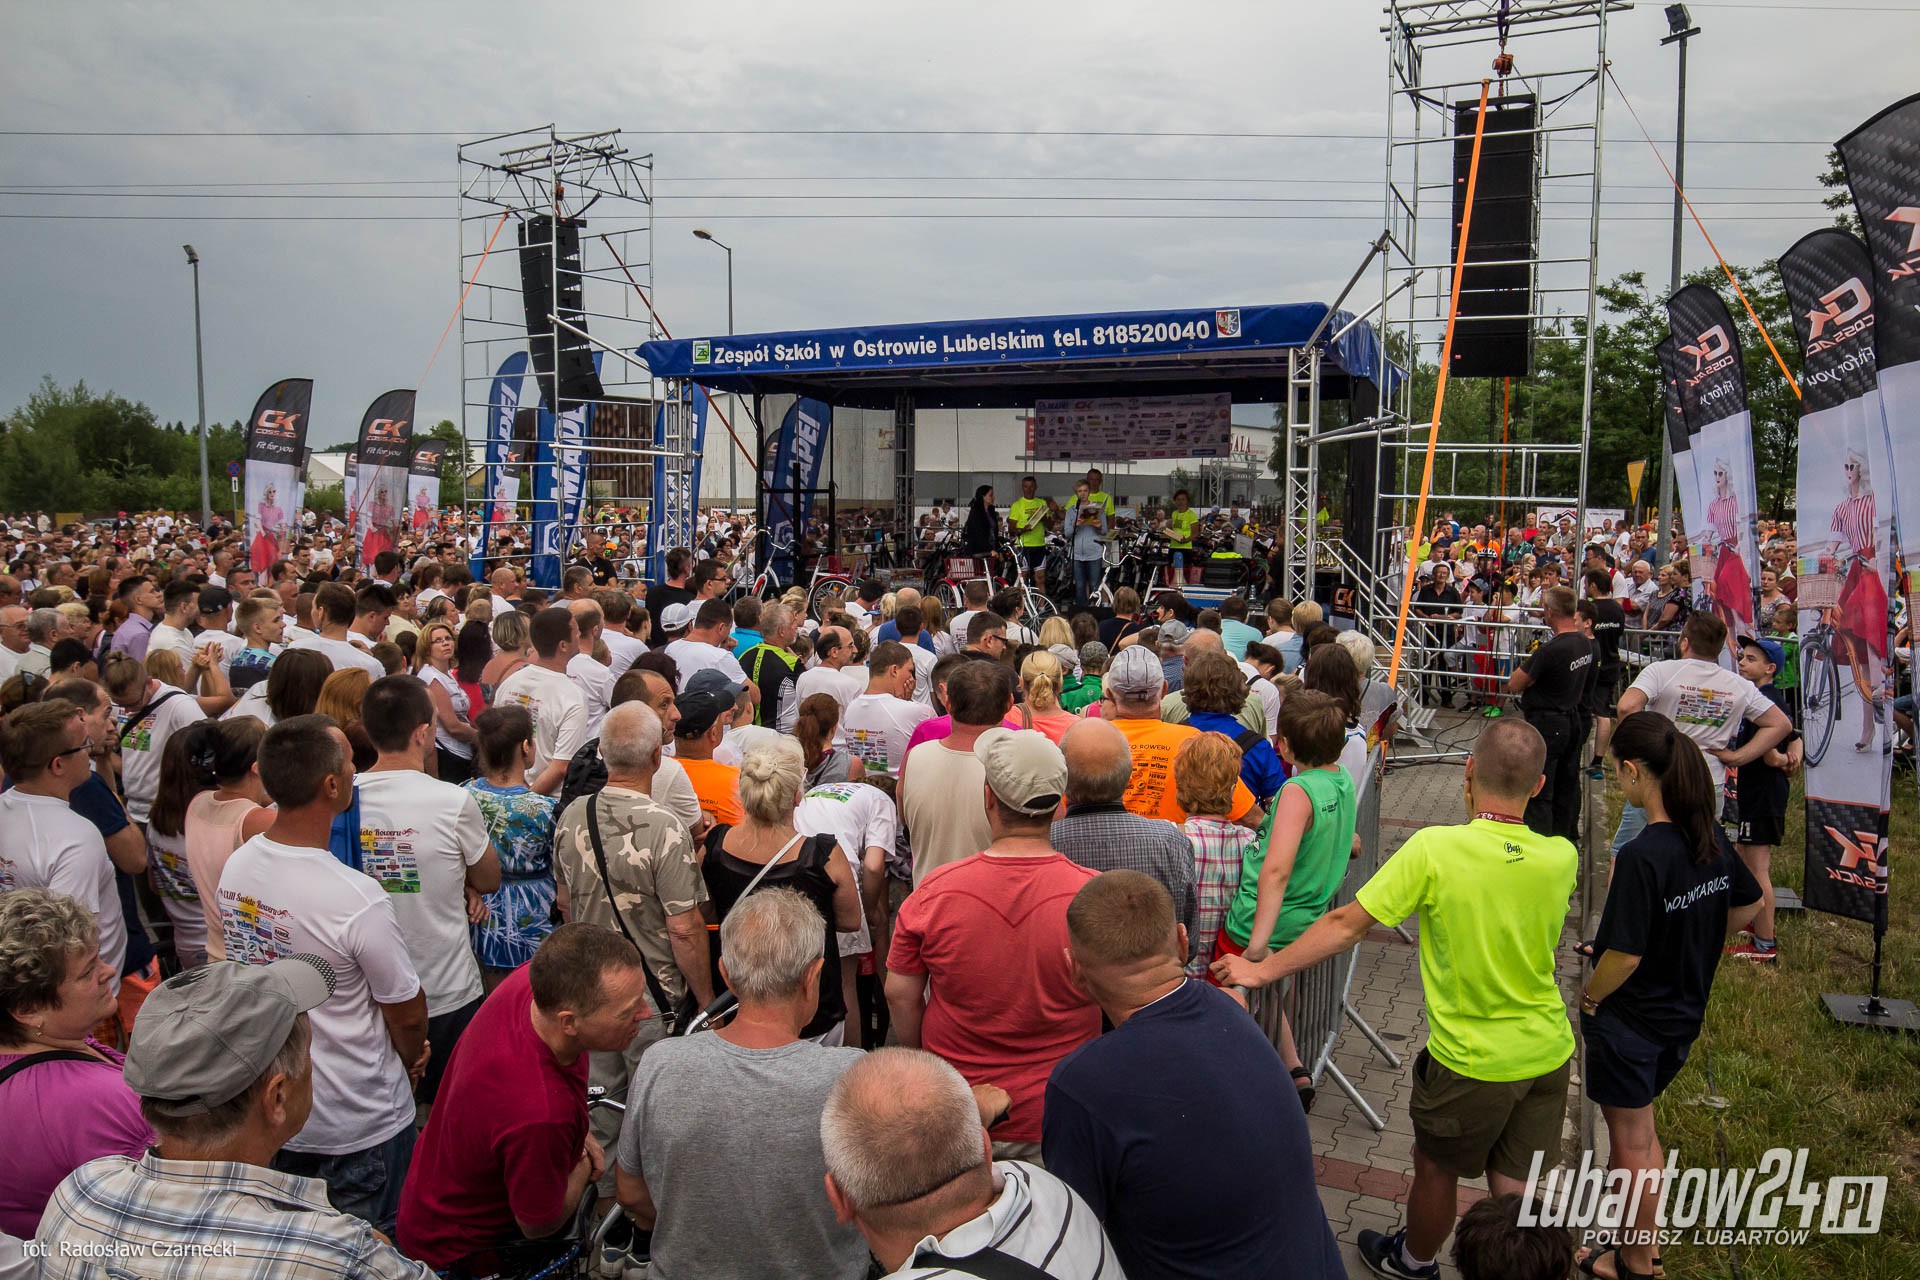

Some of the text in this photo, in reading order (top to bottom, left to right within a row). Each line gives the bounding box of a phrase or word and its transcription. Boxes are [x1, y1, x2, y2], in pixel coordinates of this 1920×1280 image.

[714, 320, 1210, 367] Zespół Szkół w Ostrowie Lubelskim tel. 818520040
[550, 406, 586, 505] MAPE
